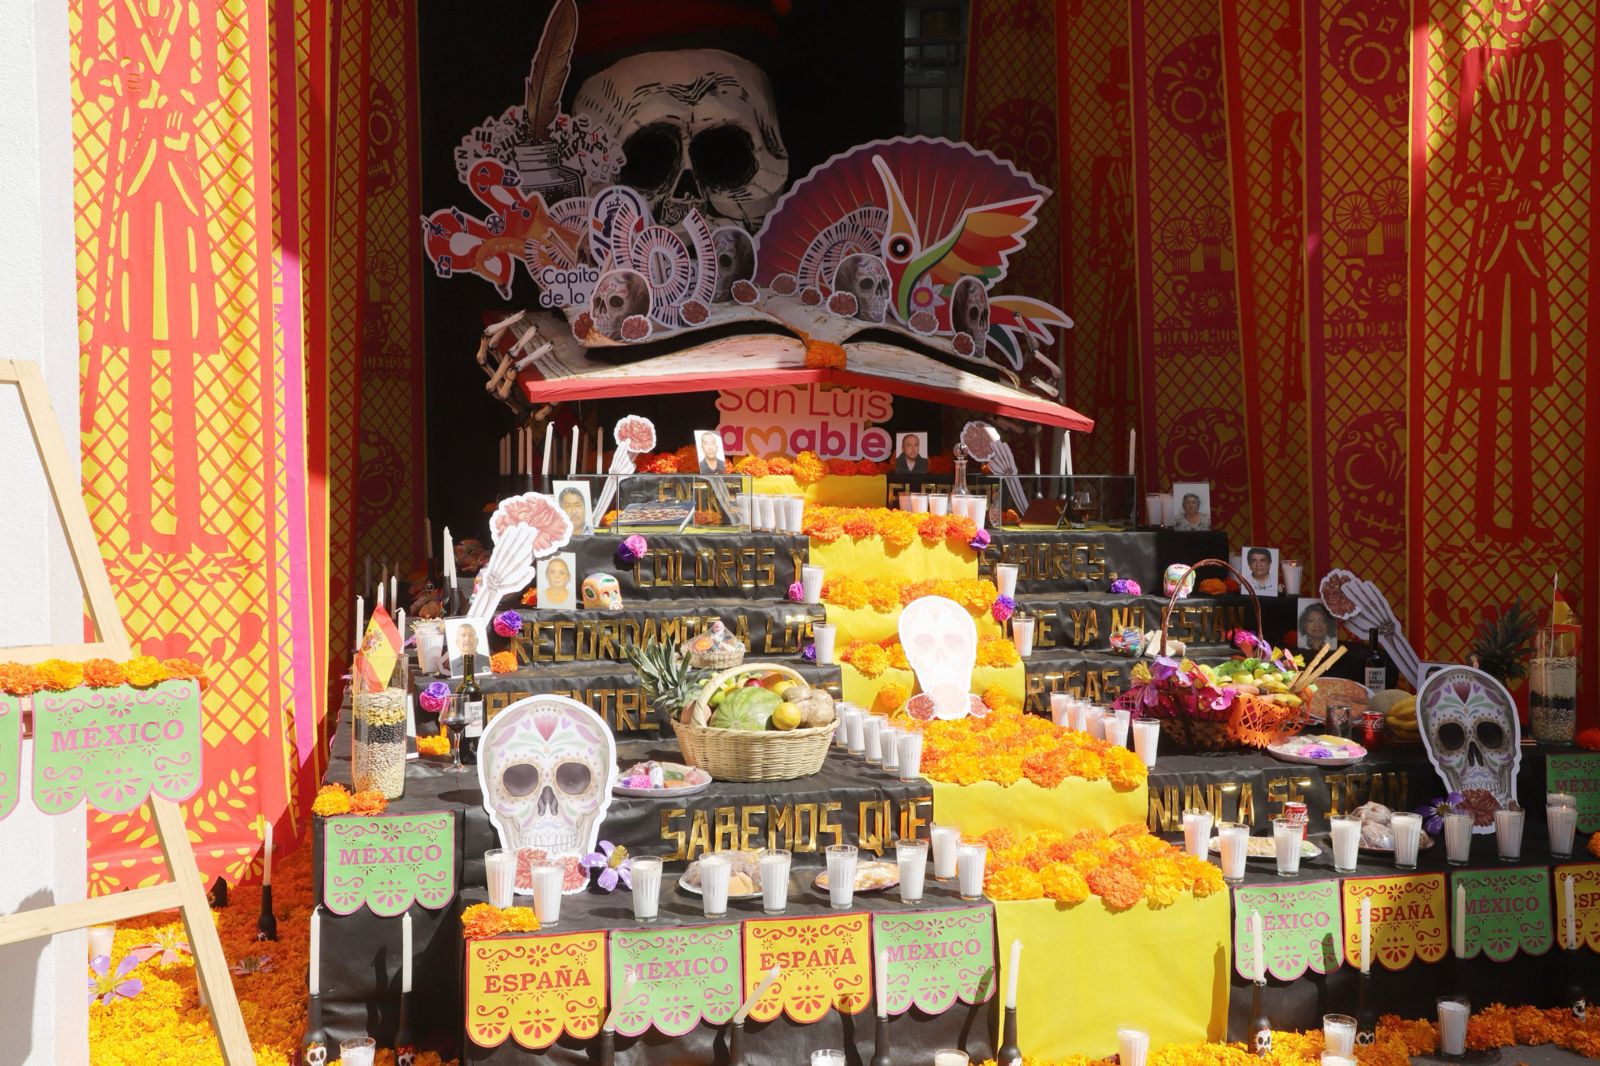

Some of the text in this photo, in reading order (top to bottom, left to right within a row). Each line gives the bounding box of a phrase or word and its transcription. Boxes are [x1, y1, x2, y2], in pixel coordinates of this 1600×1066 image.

[541, 289, 564, 306] de
[569, 288, 585, 304] la
[719, 382, 888, 420] San Luis
[788, 548, 809, 587] Y
[735, 614, 752, 653] A
[1070, 608, 1099, 646] YA
[50, 718, 185, 753] MÉXICO
[660, 796, 933, 862] SABEMOS QUE
[338, 842, 442, 866] MÉXICO
[759, 944, 857, 971] ESPAÑA
[887, 938, 981, 963] MÉXICO
[484, 965, 591, 994] ESPAÑA
[624, 956, 729, 982] MÉXICO
